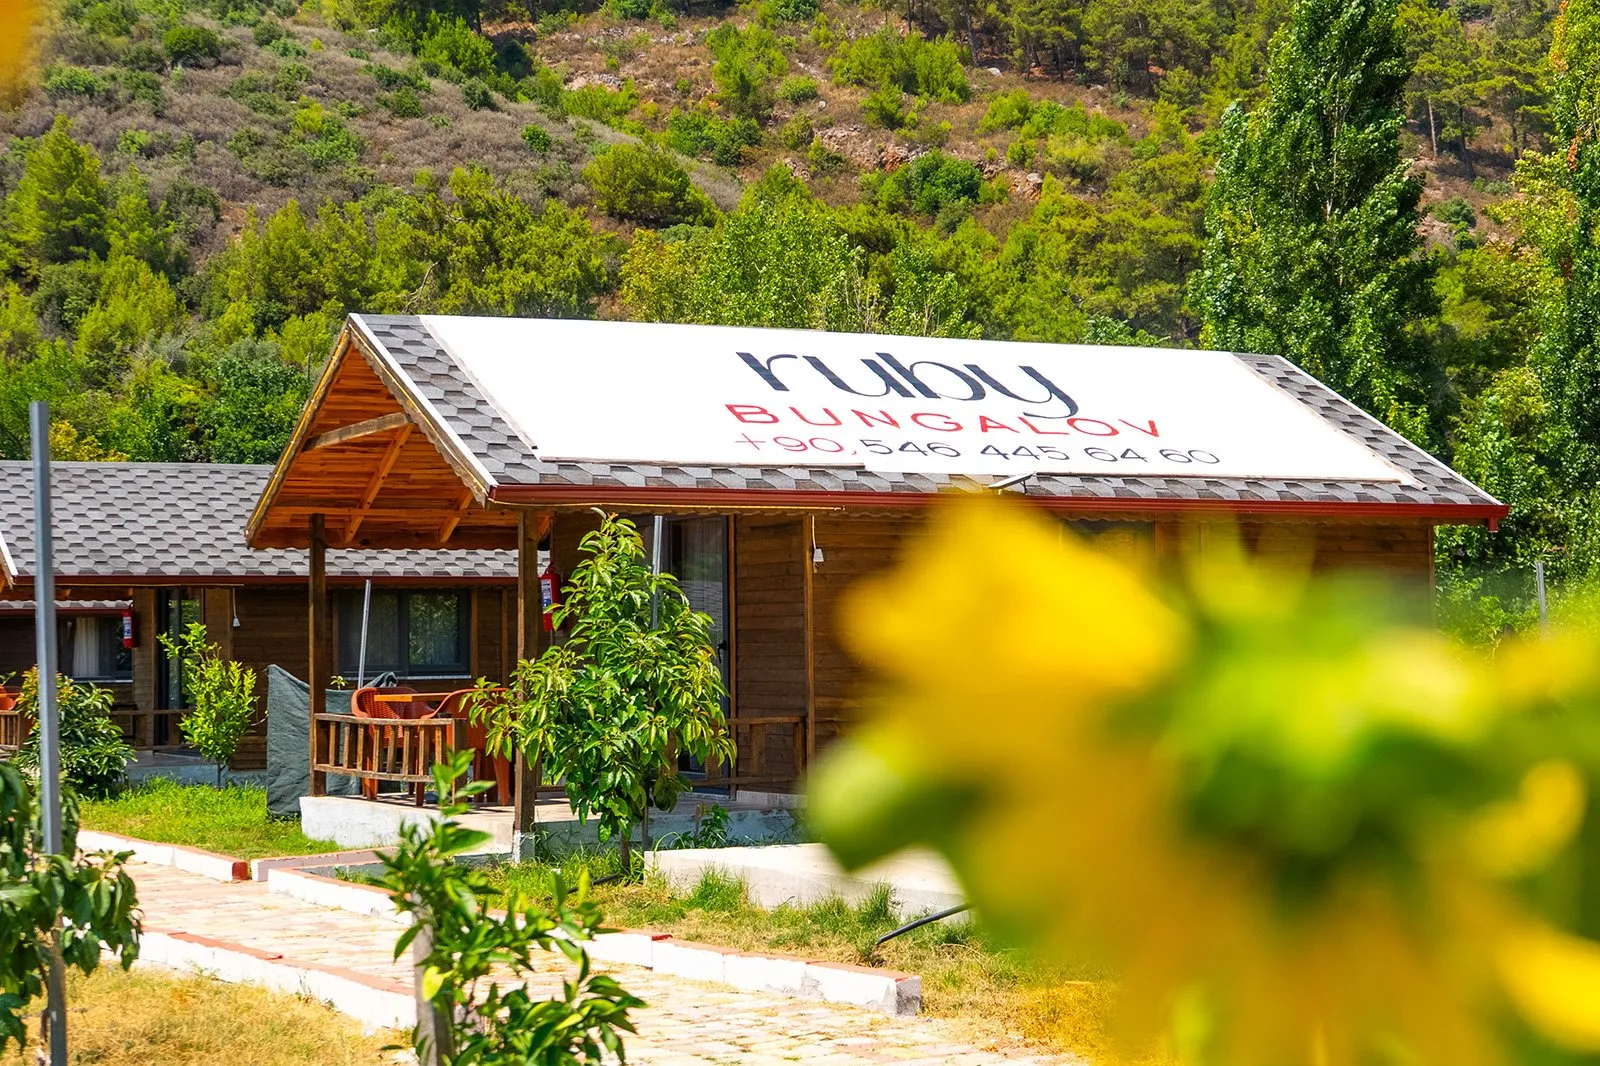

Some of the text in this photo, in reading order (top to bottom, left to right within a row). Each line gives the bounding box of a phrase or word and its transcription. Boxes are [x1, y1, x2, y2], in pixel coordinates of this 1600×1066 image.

[735, 351, 1079, 419] ruby
[725, 403, 1160, 437] BUNGALOV
[859, 439, 962, 458] 546
[980, 444, 1071, 460] 445
[1083, 446, 1149, 463] 64
[1158, 448, 1221, 464] 60
